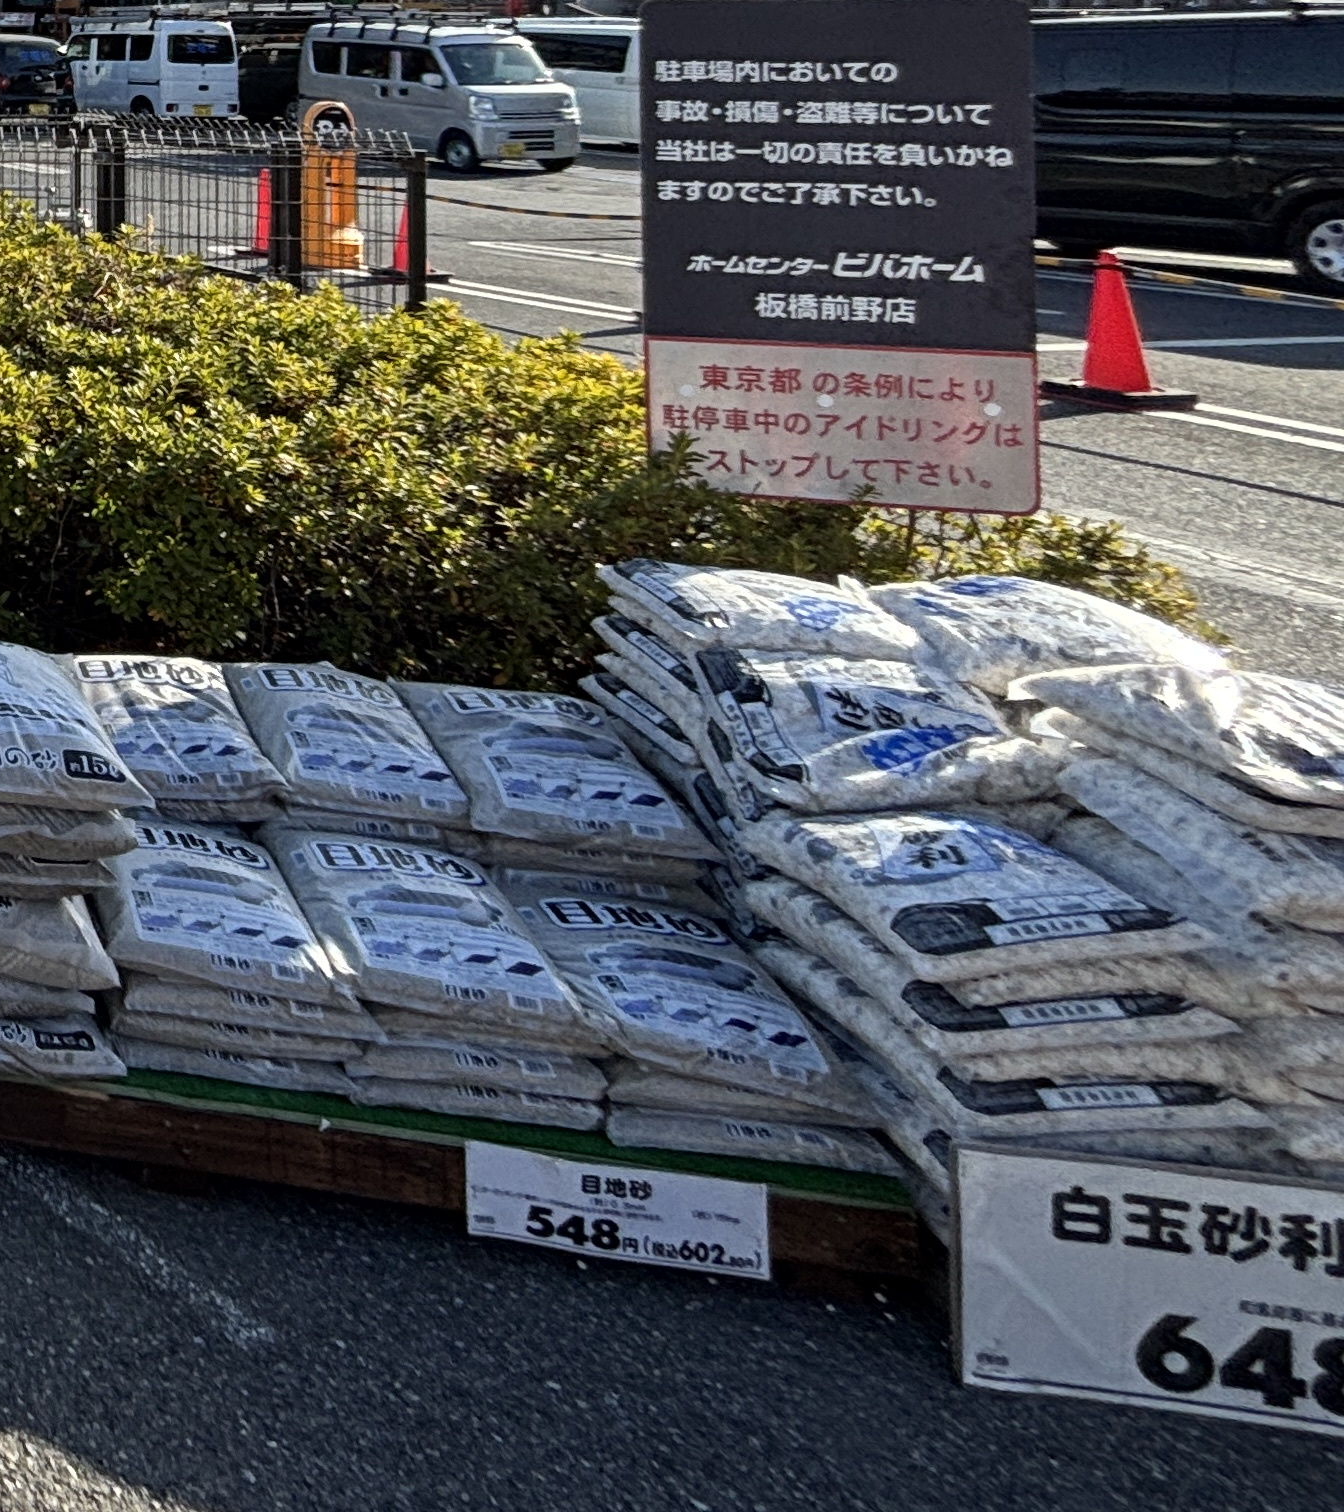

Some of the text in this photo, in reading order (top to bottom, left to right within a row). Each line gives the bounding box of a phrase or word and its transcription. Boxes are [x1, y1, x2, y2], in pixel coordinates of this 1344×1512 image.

[654, 59, 899, 84] 駐車場内においての
[654, 100, 993, 126] 事故・損傷・盗難等について
[654, 140, 1014, 167] 当社は一切の責任を負いかね
[656, 180, 938, 208] ますのでご了承下さい。
[686, 252, 986, 283] ホームセンタービバホーム
[754, 292, 918, 324] 板橋前野店
[662, 404, 1025, 448] 駐停車中のアイドリングは
[705, 448, 994, 490] ストップして下さい。
[315, 842, 476, 880] 目地砂
[544, 900, 720, 940] 目地砂
[581, 1173, 653, 1201] 目地砂
[1050, 1185, 1344, 1278] 白玉砂利
